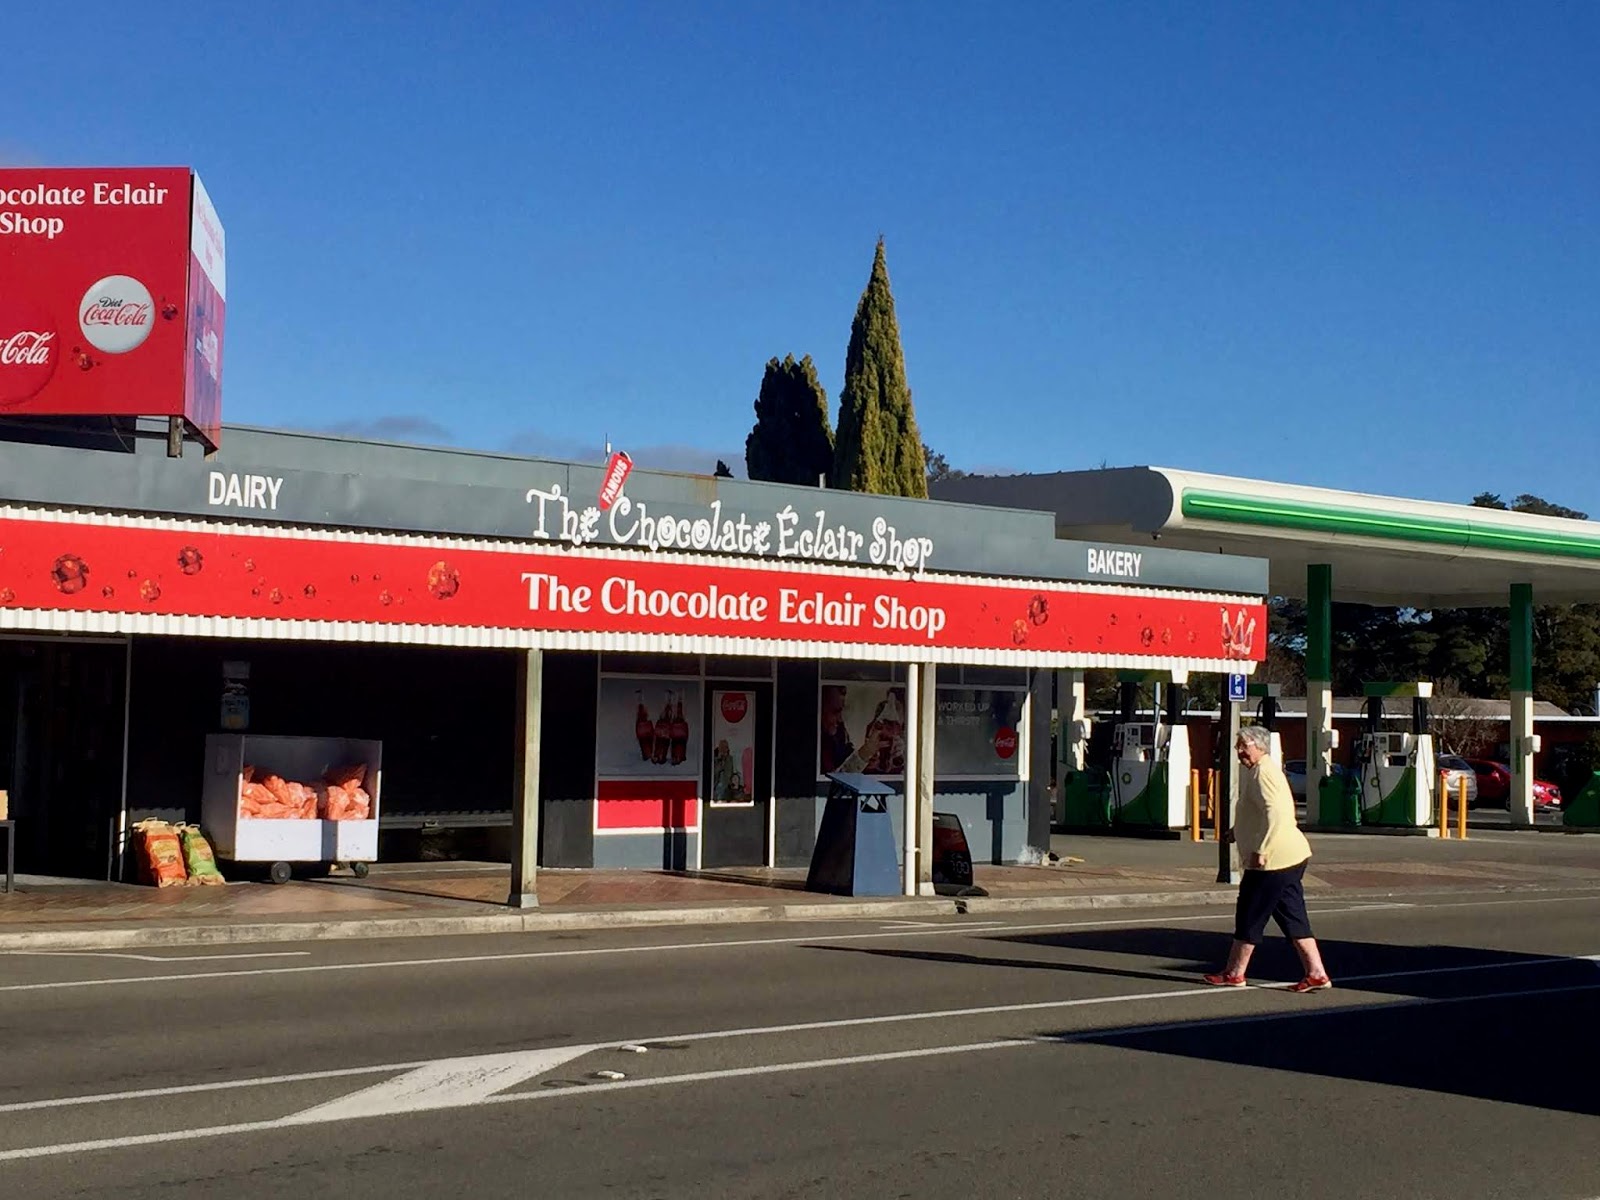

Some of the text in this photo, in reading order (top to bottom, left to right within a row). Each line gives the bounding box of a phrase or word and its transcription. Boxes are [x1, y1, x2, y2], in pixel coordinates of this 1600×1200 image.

[93, 182, 169, 205] Eclair
[0, 211, 64, 239] Shop
[83, 303, 151, 326] Coca-Cola
[99, 297, 123, 308] Diet
[208, 471, 284, 510] DAIRY
[601, 459, 628, 504] FAMOUS
[526, 484, 934, 575] The Chocolate Éclair Shop
[1087, 548, 1142, 578] BAKERY
[521, 572, 946, 638] The Chocolate Eclair Shop
[1235, 674, 1242, 685] P
[977, 702, 991, 712] UP
